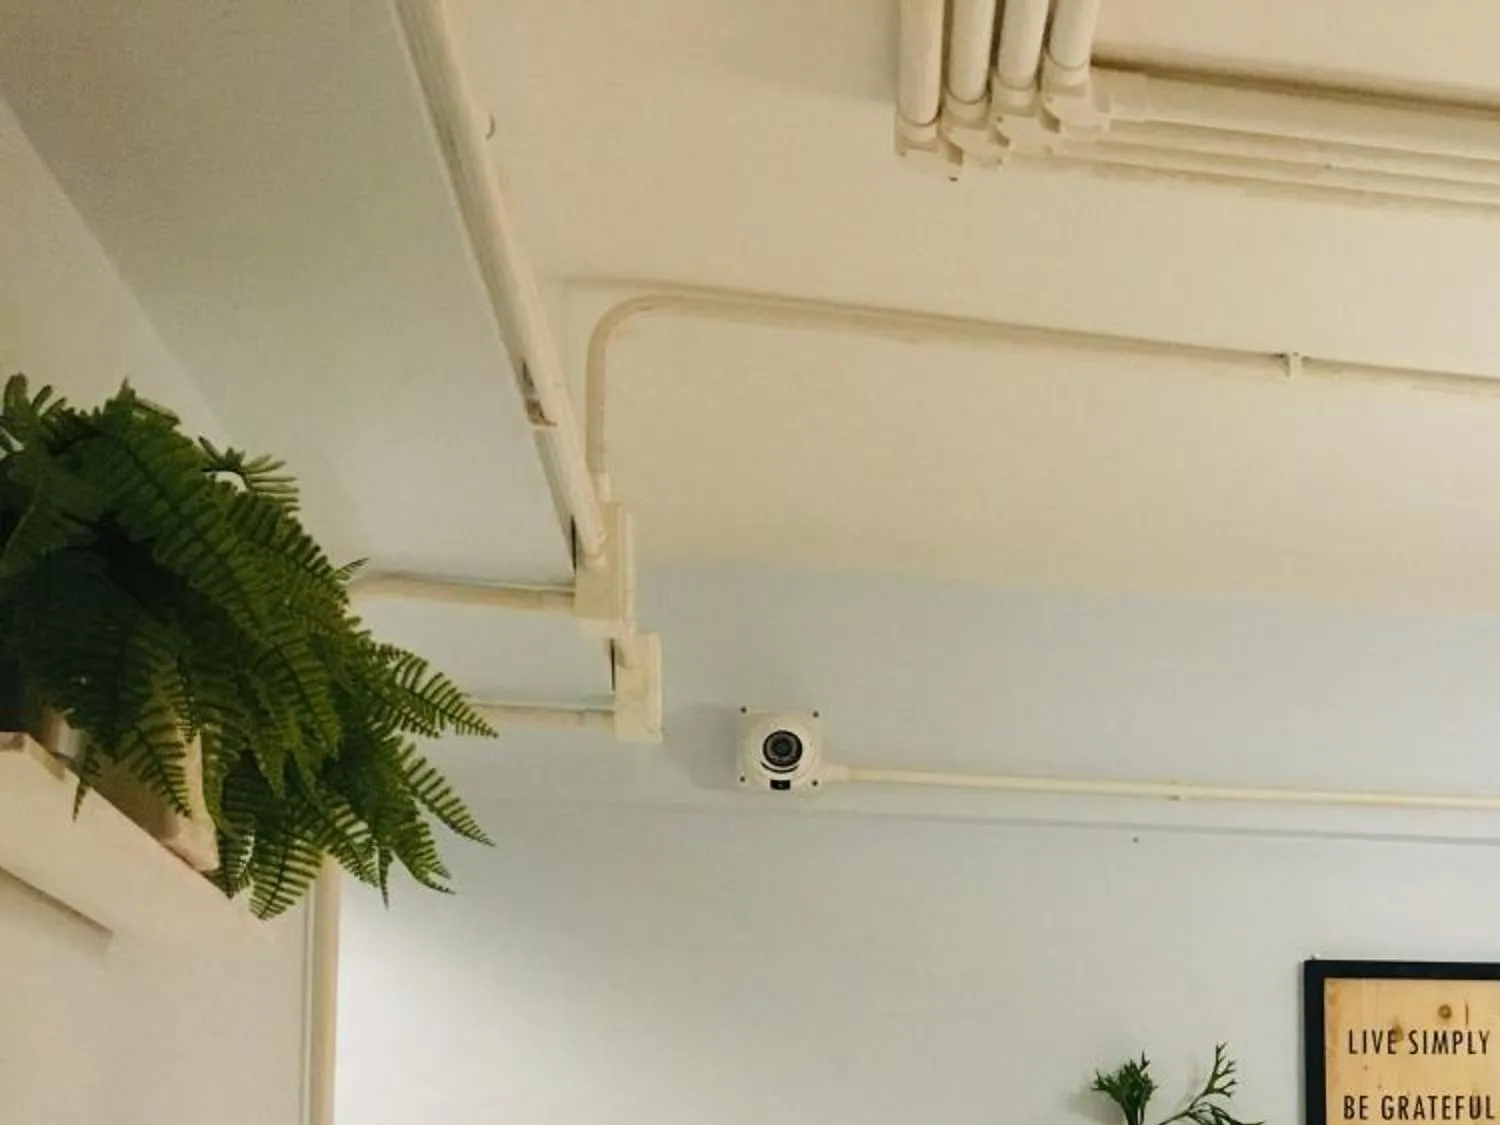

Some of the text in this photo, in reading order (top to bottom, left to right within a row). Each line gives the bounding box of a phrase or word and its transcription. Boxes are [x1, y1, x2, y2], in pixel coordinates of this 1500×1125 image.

[1348, 1028, 1490, 1055] LIVE SIMPLY
[1343, 1095, 1496, 1121] BE GRATEFUL
